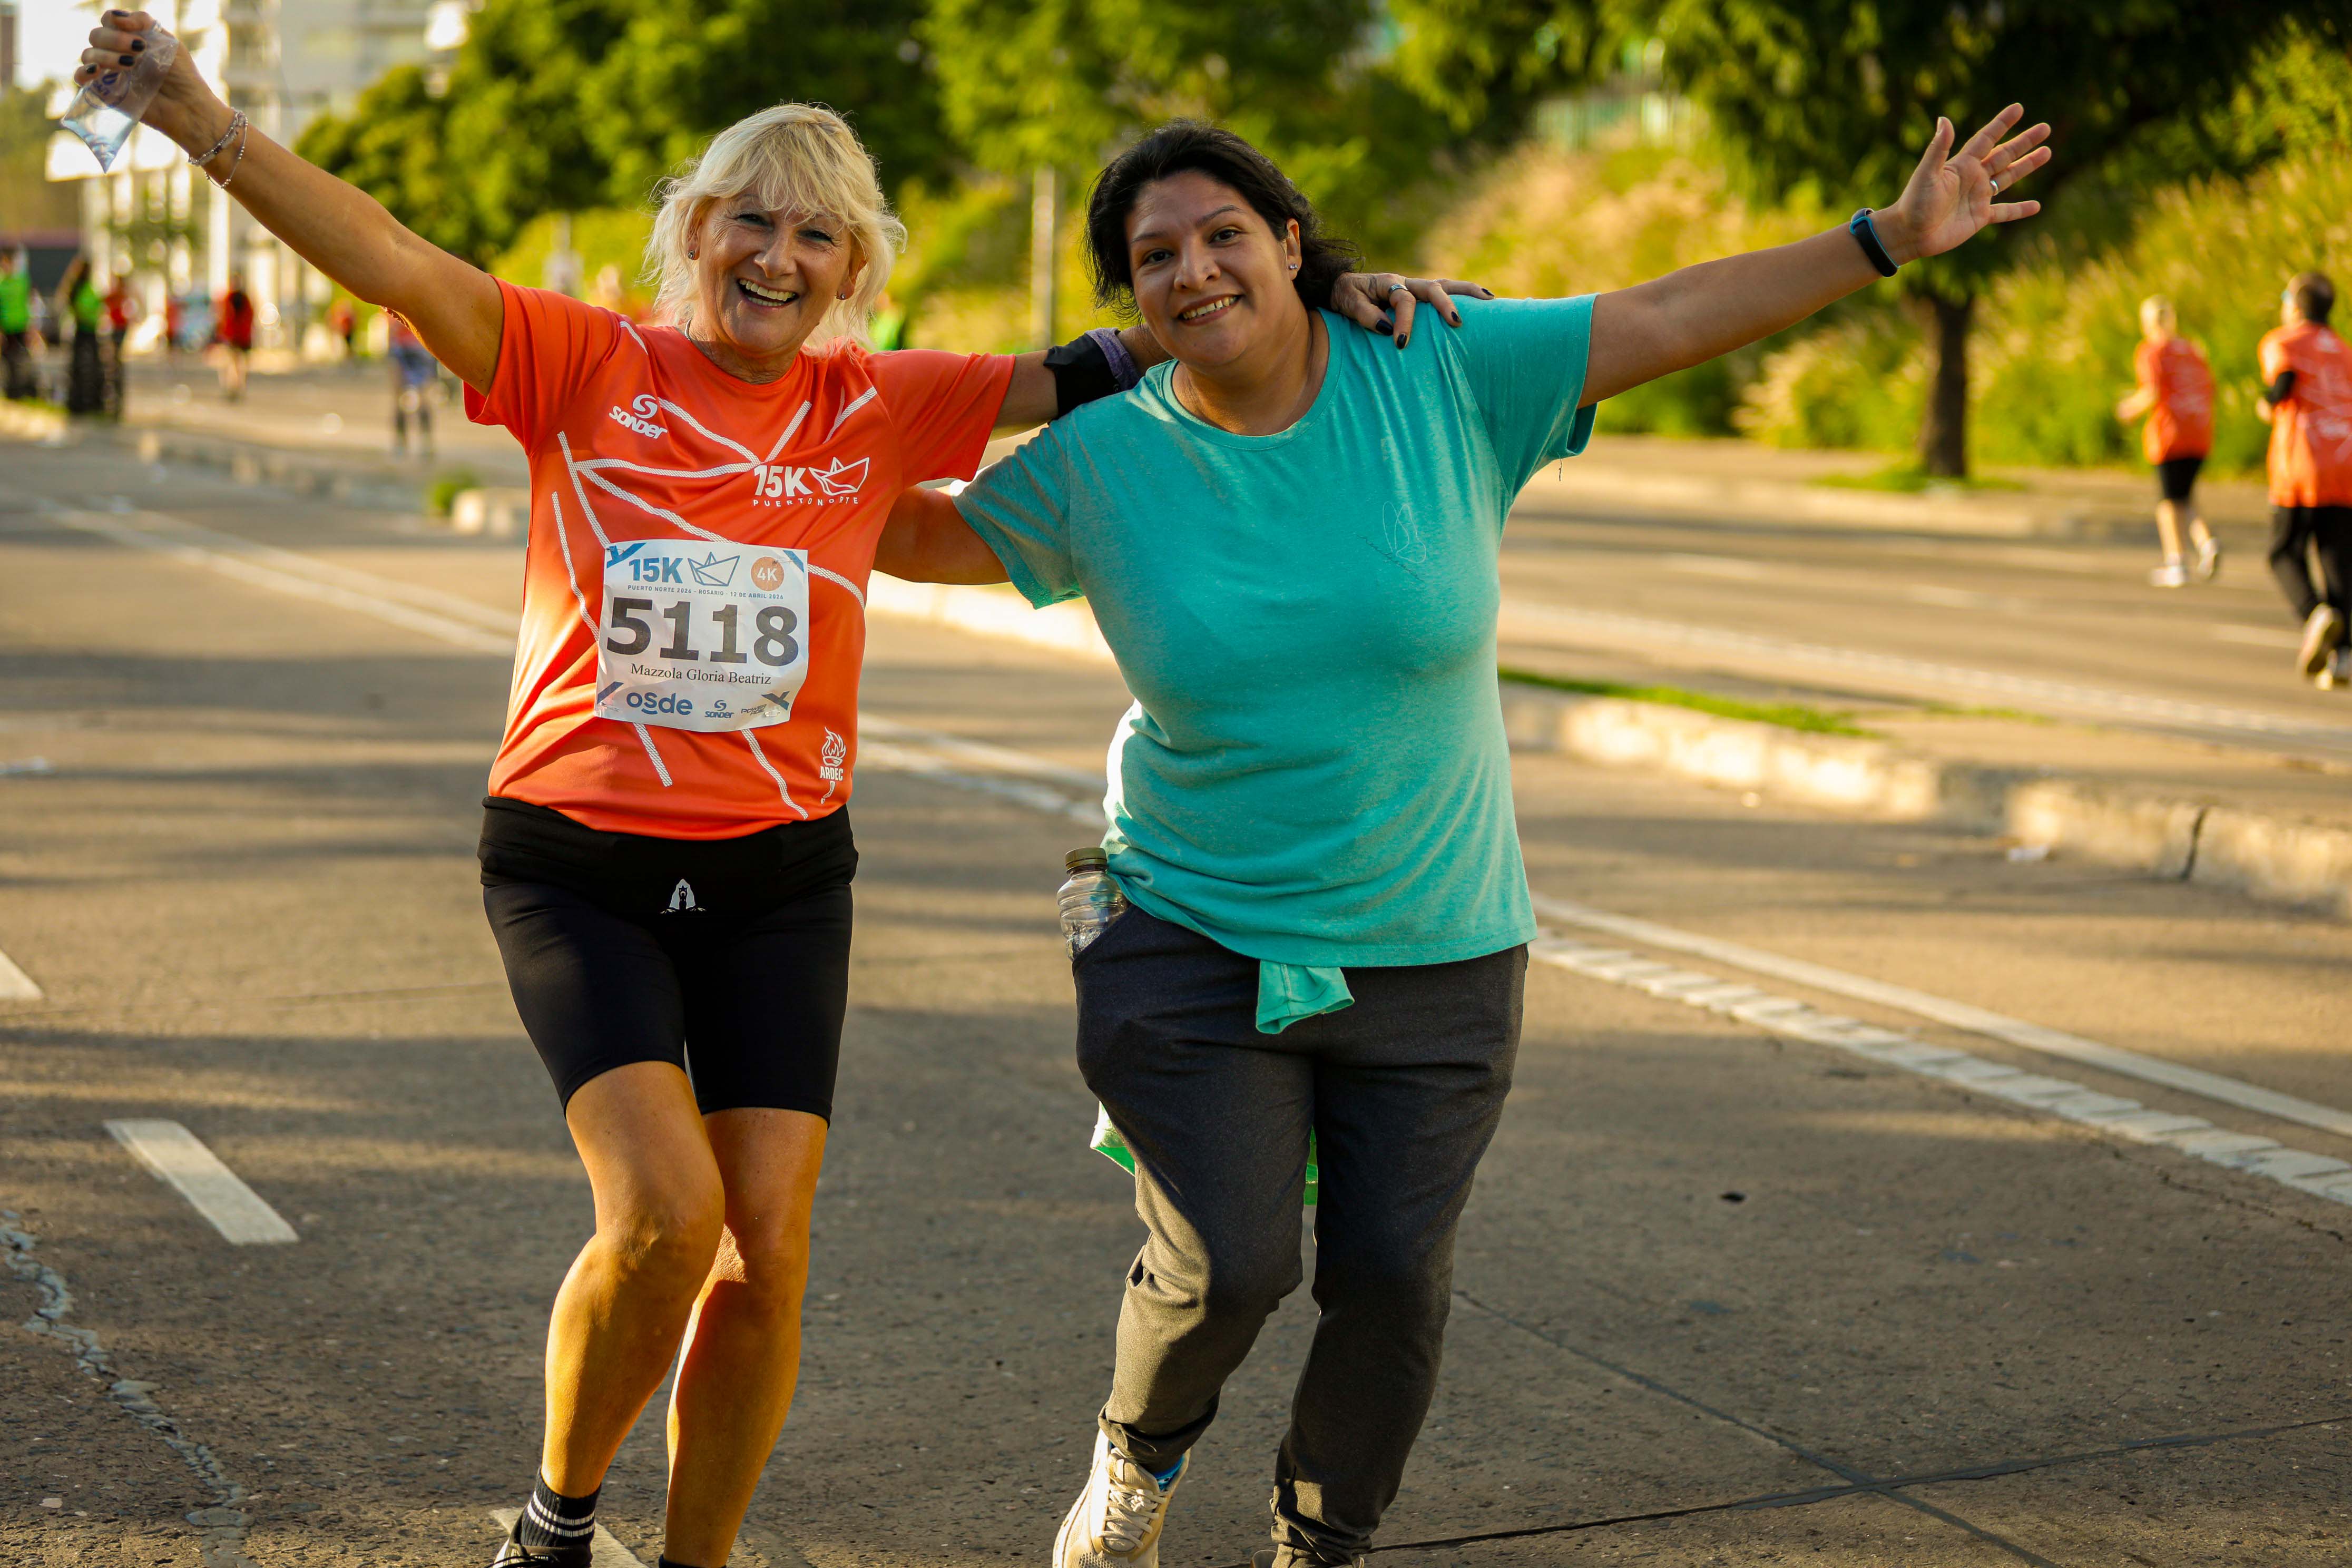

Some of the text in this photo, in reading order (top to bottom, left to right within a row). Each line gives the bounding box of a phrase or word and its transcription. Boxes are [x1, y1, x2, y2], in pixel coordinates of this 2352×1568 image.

[754, 465, 814, 497] 15K
[629, 557, 683, 584] 15K
[757, 570, 778, 582] 4K
[606, 596, 799, 667] 5118
[631, 663, 771, 685] Mazzola Gloria Beatriz
[626, 692, 693, 715] osde
[820, 766, 844, 781] ARDEC
